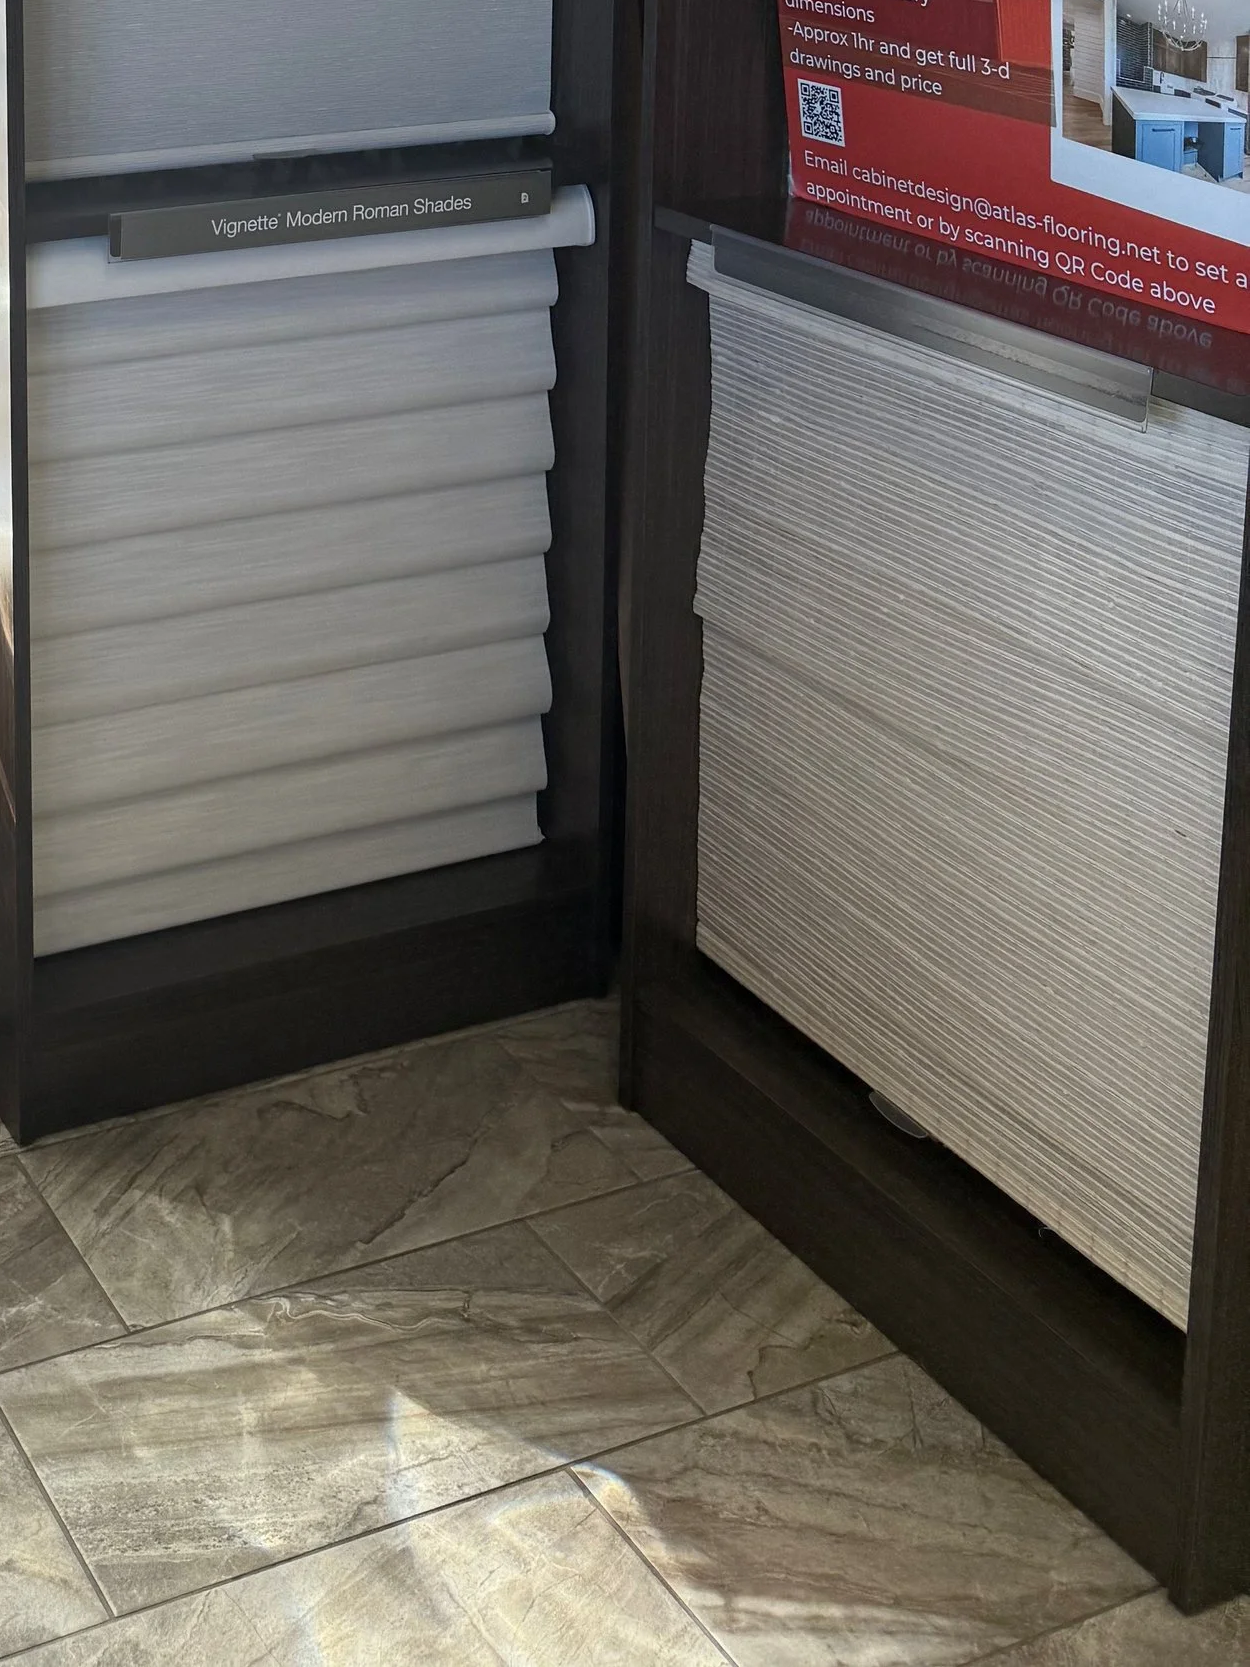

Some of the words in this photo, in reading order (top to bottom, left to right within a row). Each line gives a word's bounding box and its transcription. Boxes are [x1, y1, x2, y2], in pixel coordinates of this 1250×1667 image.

[788, 21, 849, 47] -Approx
[851, 32, 875, 52] 1hr
[879, 42, 911, 60] and
[915, 48, 945, 67] get
[949, 51, 976, 73] full
[980, 57, 1011, 80] 3-d
[789, 48, 861, 79] drawings
[864, 66, 896, 85] and
[900, 74, 943, 95] price
[286, 208, 348, 229] Modern
[352, 202, 409, 222] Roman
[413, 195, 472, 215] Shades
[804, 150, 848, 176] Email
[852, 166, 1161, 265] cabinetdesign@atlas-flooring.net
[1166, 250, 1189, 272] to
[1195, 260, 1230, 284] set
[1235, 272, 1248, 289] a
[806, 181, 913, 224] appointment
[916, 213, 935, 230] or
[939, 216, 960, 241] by
[964, 227, 1050, 268] scanning
[1055, 251, 1085, 277] QR
[1090, 262, 1144, 293] Code
[1150, 280, 1216, 314] above
